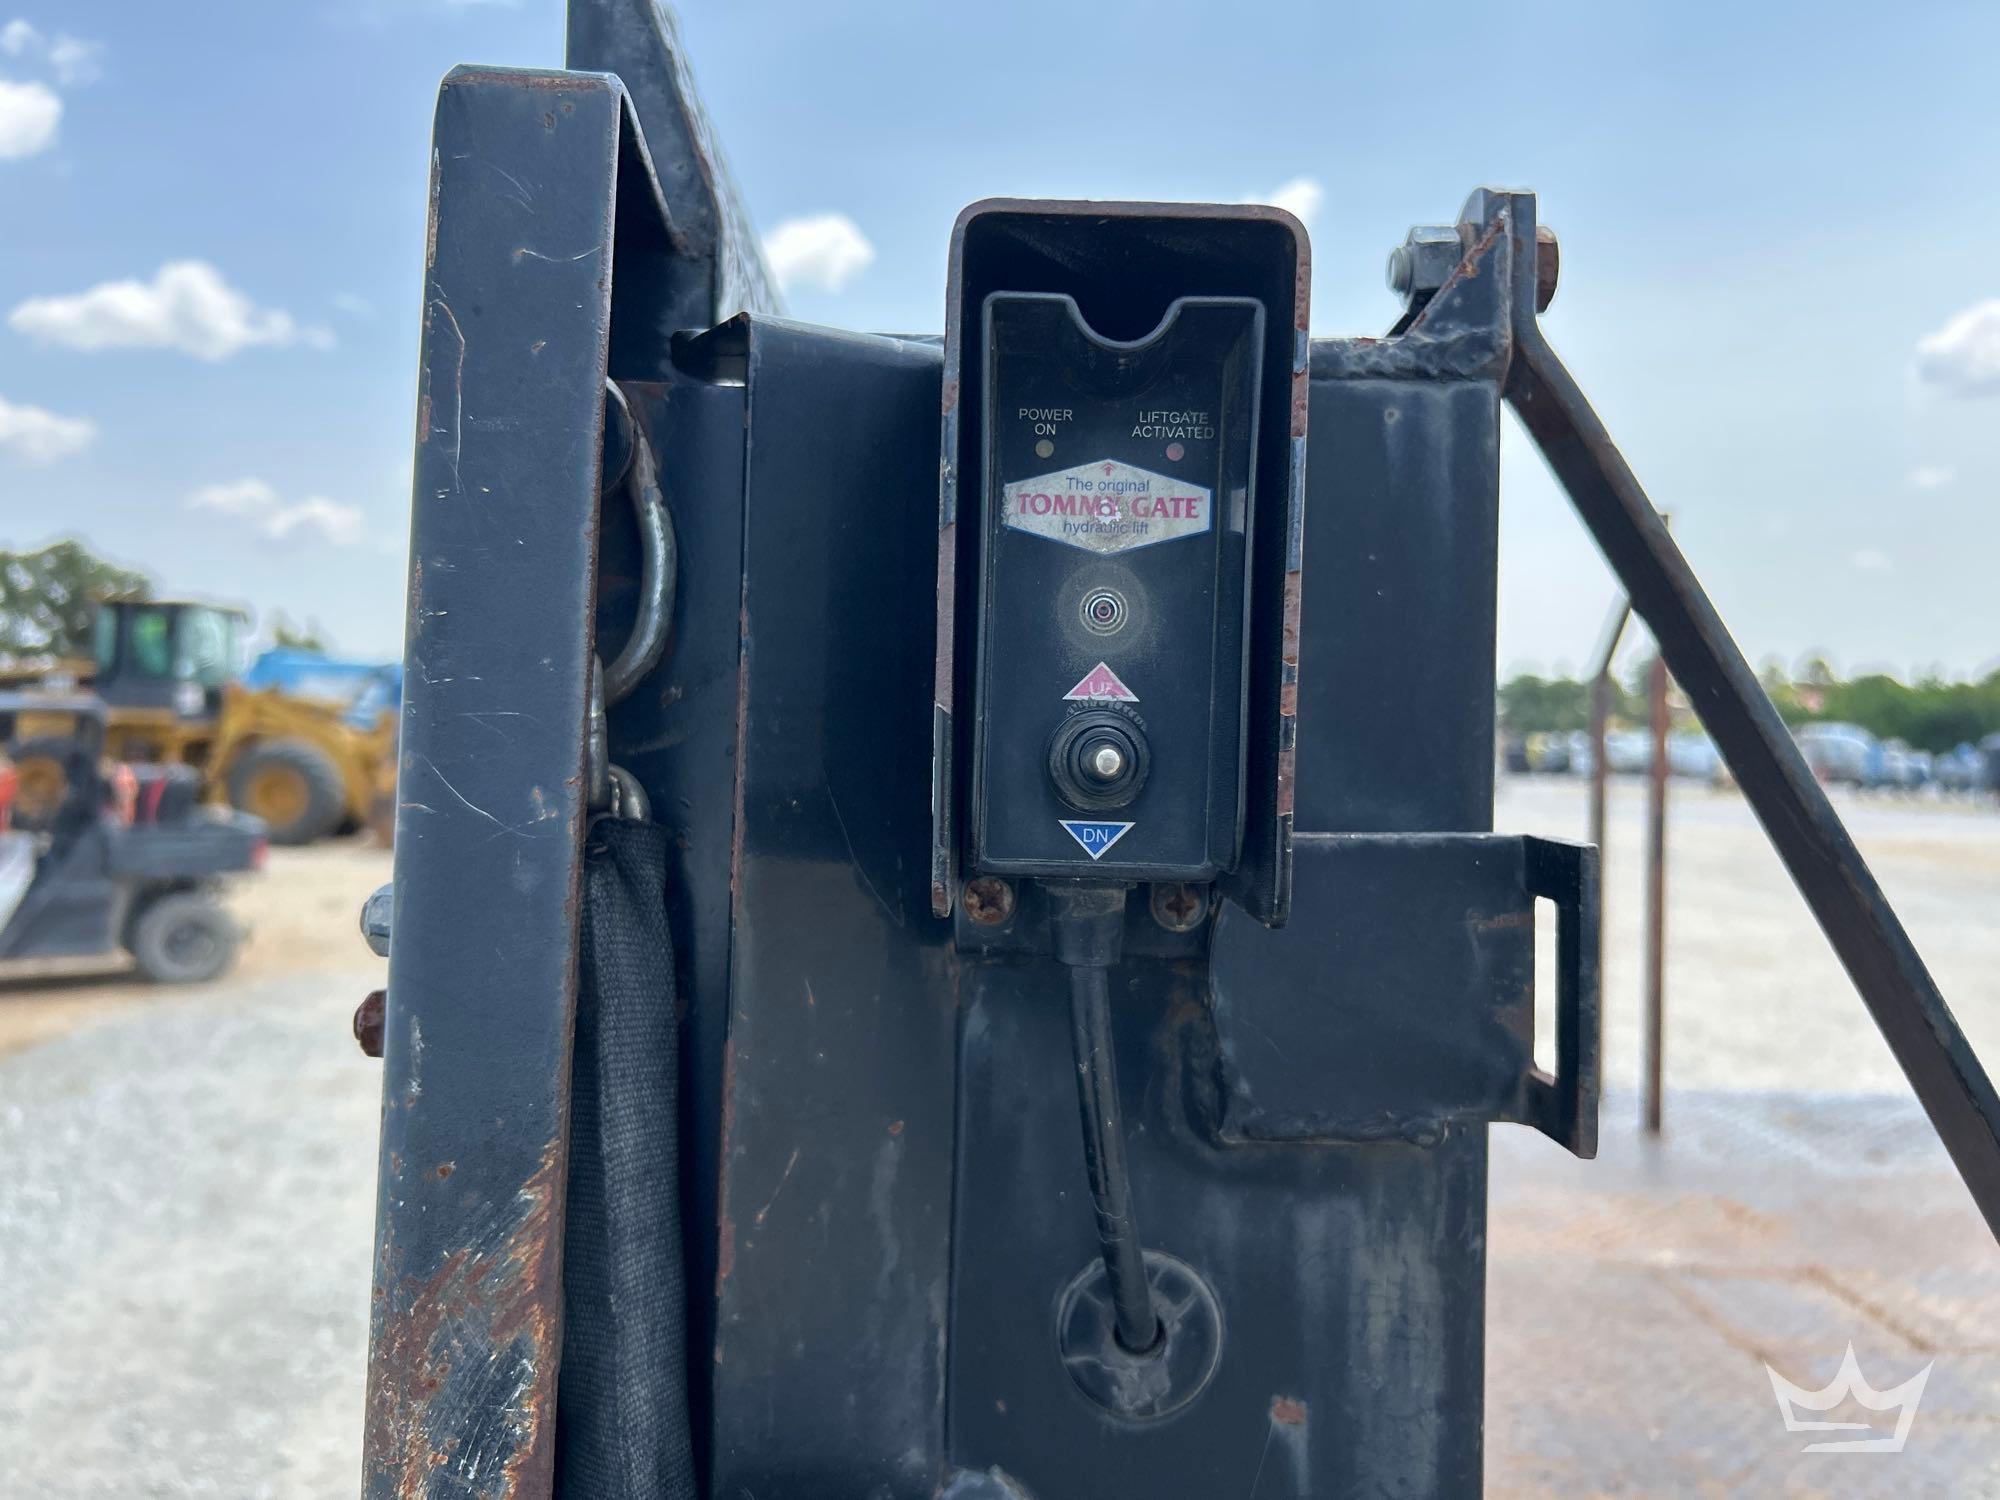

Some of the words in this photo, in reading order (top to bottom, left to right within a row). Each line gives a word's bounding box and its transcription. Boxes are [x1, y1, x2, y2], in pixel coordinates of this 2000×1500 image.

[1018, 408, 1073, 422] POWER
[1139, 411, 1209, 425] LIFTGATE
[1034, 423, 1056, 436] ON
[1131, 425, 1215, 440] ACTIVATED
[1066, 477, 1093, 492] The
[1097, 479, 1150, 495] original
[1130, 495, 1203, 519] GATE
[1132, 521, 1149, 535] lift
[1082, 827, 1109, 844] DN
